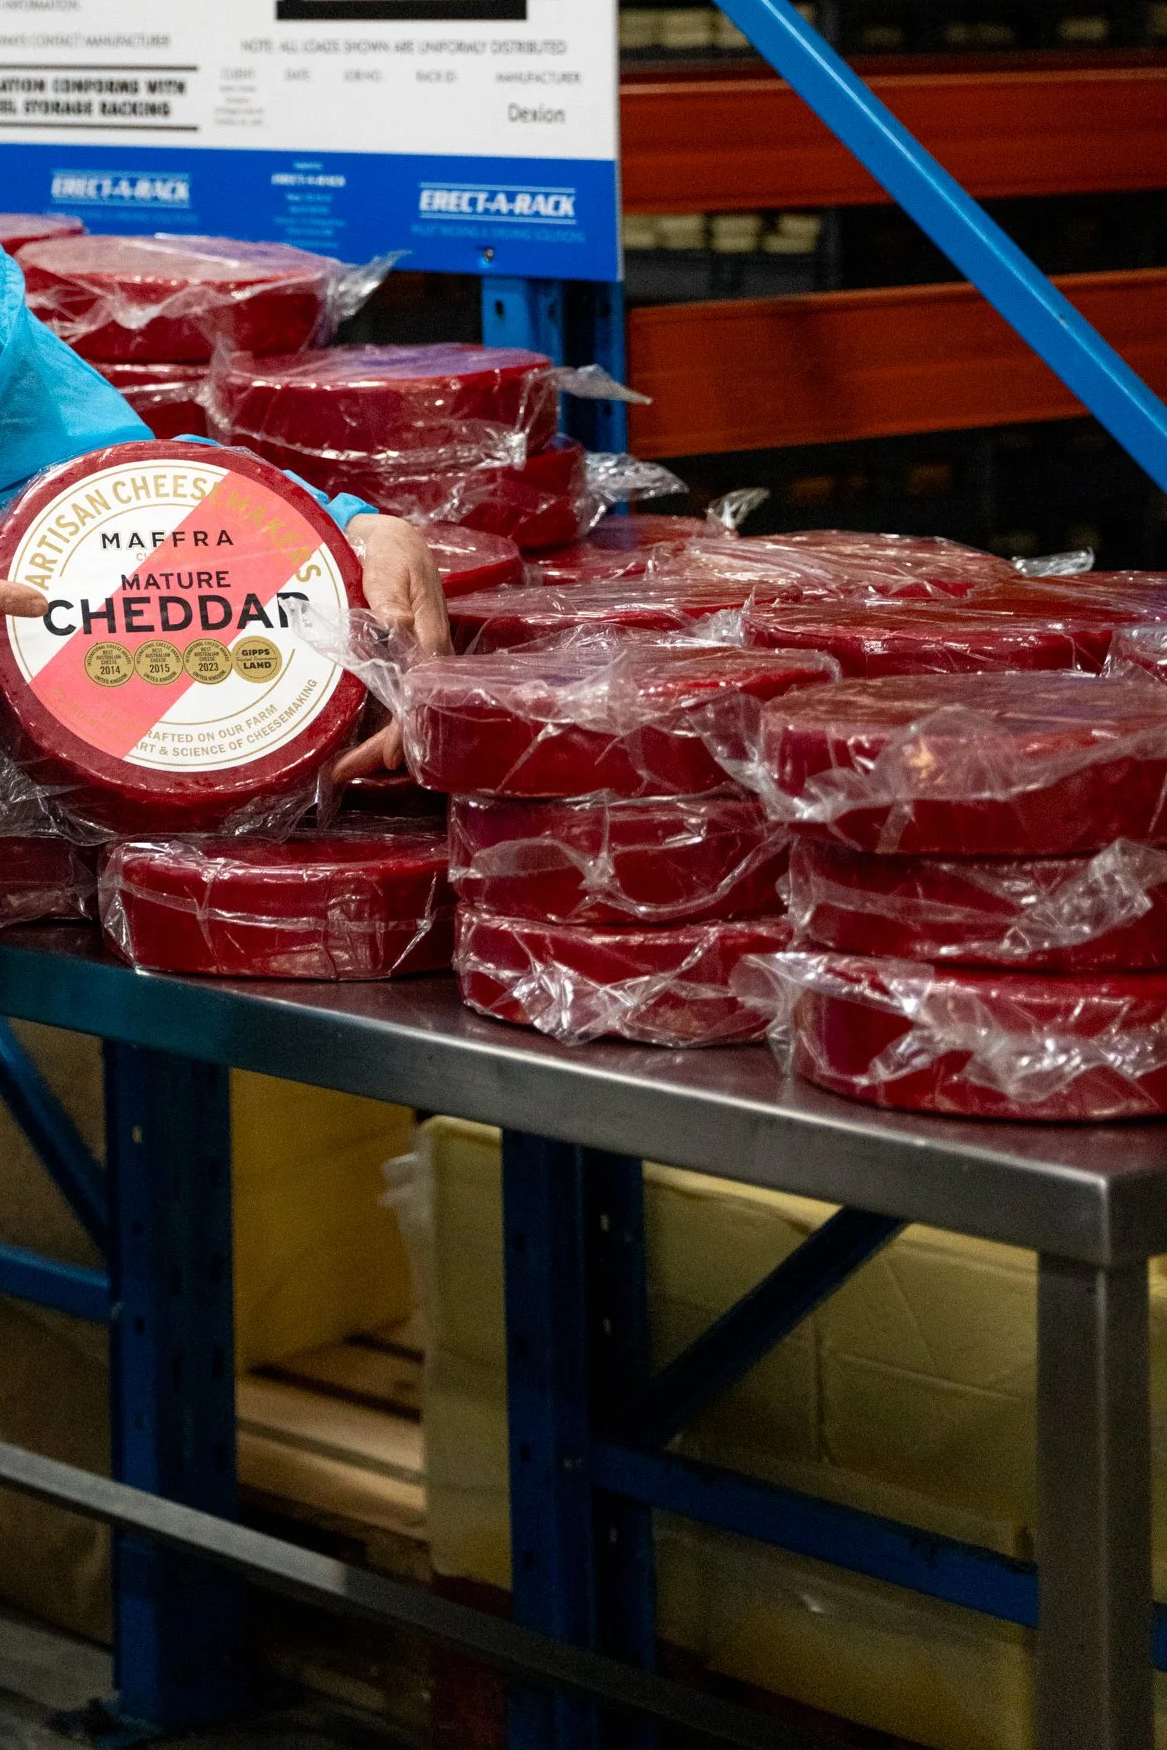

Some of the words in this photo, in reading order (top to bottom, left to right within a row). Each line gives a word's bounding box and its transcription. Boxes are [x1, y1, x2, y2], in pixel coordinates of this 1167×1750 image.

[52, 78, 139, 94] CONFORMS
[147, 79, 187, 95] WITH
[24, 100, 93, 115] STORAGE
[100, 101, 171, 117] RACKING
[507, 102, 566, 124] Dexion
[419, 190, 575, 217] ERECT-A-RACK
[24, 487, 111, 591] ARTISAN
[112, 473, 321, 583] CHEESEMAKERS
[101, 529, 234, 550] MAFFRA
[121, 571, 231, 591] MATURE
[100, 666, 121, 675] 2014
[149, 664, 170, 674] 2015
[198, 662, 219, 672] 2023
[243, 662, 272, 670] LAND
[94, 675, 110, 684] UNITED
[143, 673, 158, 683] UNITED
[192, 671, 208, 681] UNITED
[159, 746, 169, 756] &
[168, 743, 226, 757] SCIENCE
[229, 738, 244, 750] OF
[247, 678, 318, 744] CHEESEMAKING
[197, 733, 215, 742] ON
[218, 725, 244, 739] OUR
[246, 703, 278, 729] FARM
